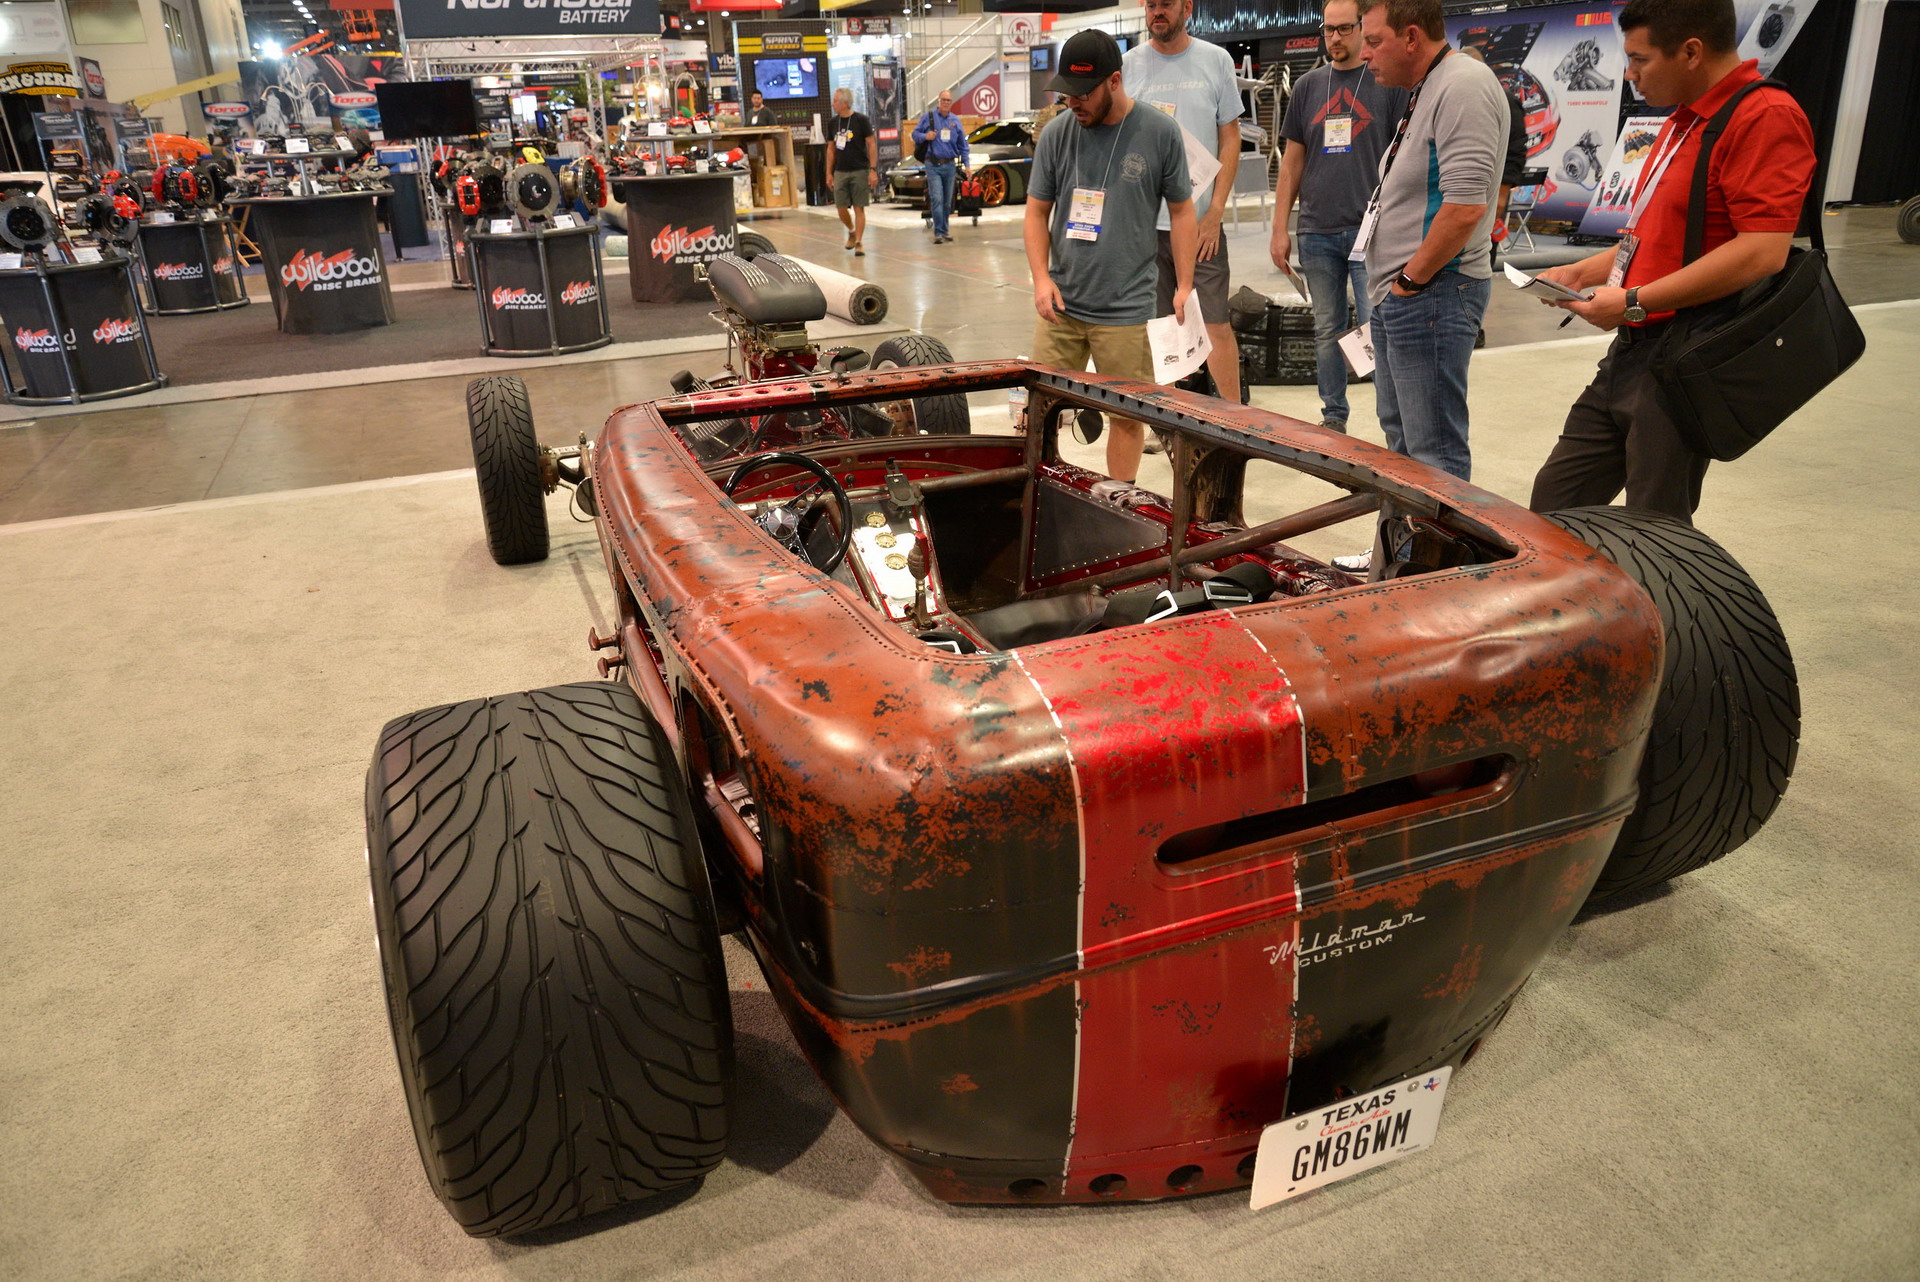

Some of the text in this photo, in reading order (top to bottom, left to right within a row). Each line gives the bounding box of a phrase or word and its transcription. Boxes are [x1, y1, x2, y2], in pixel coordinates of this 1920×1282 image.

[559, 9, 630, 24] BATTERY
[765, 36, 800, 44] SPRINT
[1286, 36, 1319, 48] CORSA
[333, 95, 376, 104] Torco
[206, 105, 248, 114] Torco
[651, 225, 735, 255] wilwood
[281, 248, 380, 282] wilwood
[675, 256, 701, 264] DISC
[154, 262, 204, 277] wilwood
[314, 282, 342, 292] DISC
[1299, 934, 1393, 967] CUSTOM
[1322, 1089, 1397, 1126] TEXAS
[1320, 1109, 1391, 1137] Classic Auto
[1292, 1109, 1411, 1182] GM86WM
